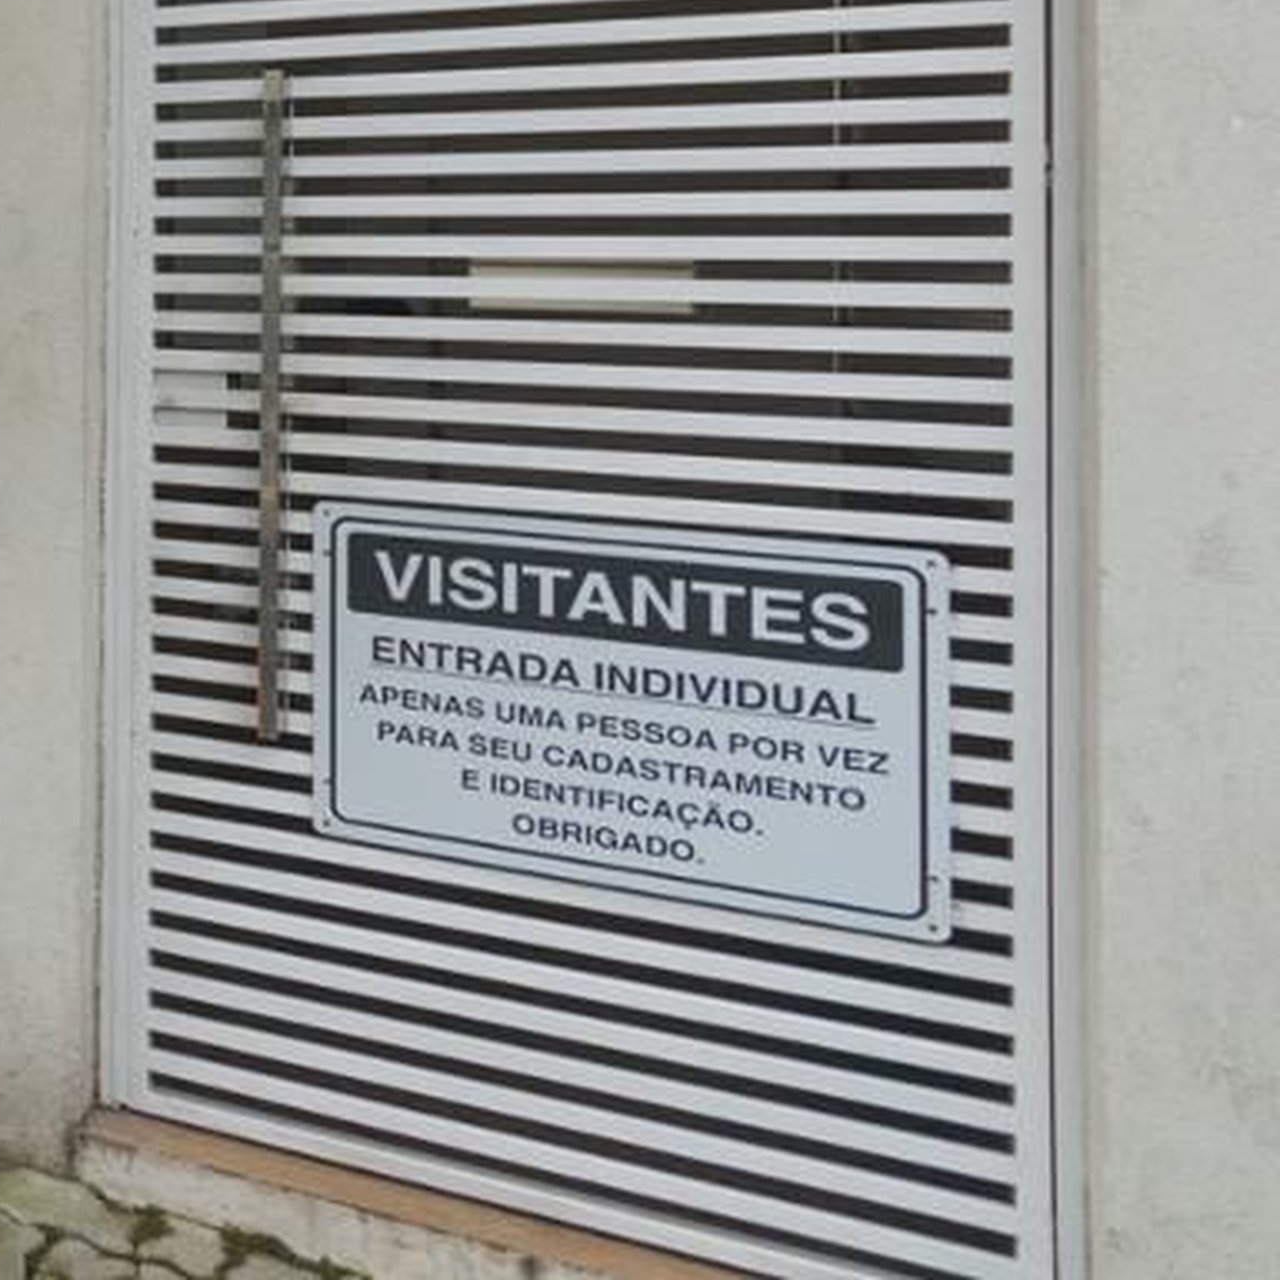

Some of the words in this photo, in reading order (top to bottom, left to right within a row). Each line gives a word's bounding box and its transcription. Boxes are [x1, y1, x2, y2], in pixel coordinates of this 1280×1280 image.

[373, 550, 871, 652] VISITANTES
[372, 635, 580, 689] ENTRADA
[594, 661, 877, 725] INDIVIDUAL
[358, 683, 485, 720] APENAS
[495, 701, 566, 731] UMA
[576, 712, 718, 752] PESSOA
[728, 732, 806, 764] POR
[818, 745, 890, 776] VEZ
[377, 721, 460, 752] PARA
[468, 733, 532, 764] SEU
[542, 745, 867, 812] CADASTRAMENTO
[460, 769, 481, 792] E
[490, 773, 765, 837] IDENTIFICAÇÃO.
[511, 813, 706, 866] OBRIGADO.
